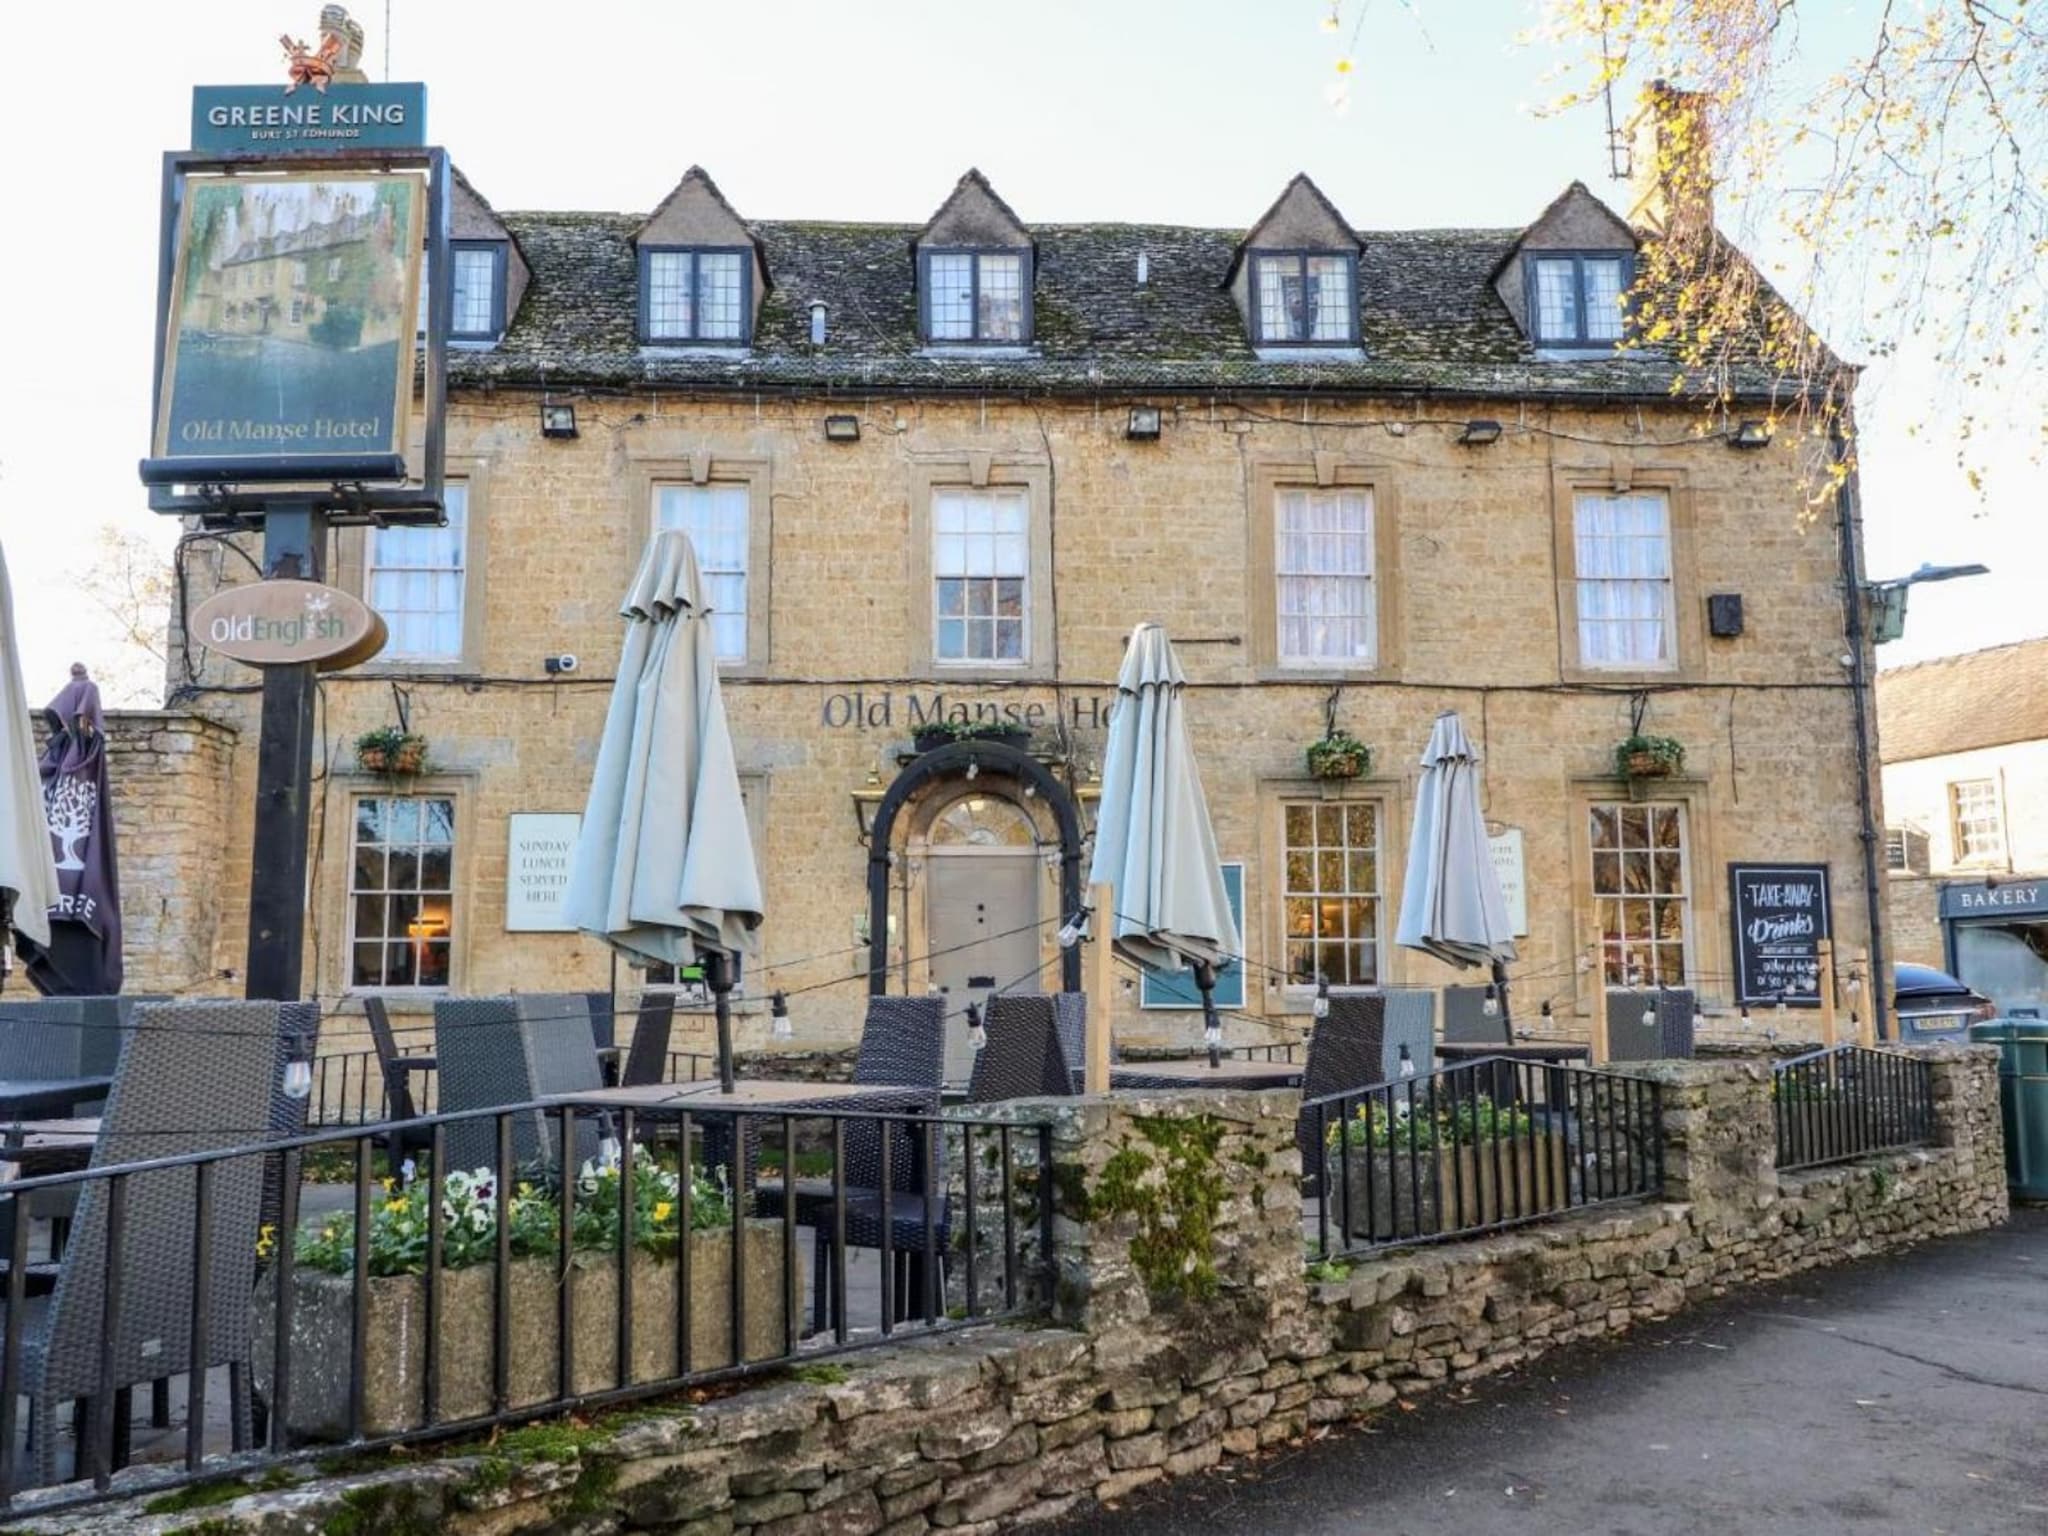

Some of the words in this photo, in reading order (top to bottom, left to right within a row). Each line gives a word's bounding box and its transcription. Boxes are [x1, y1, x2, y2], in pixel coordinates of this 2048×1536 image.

[208, 105, 320, 126] GREENE
[332, 104, 405, 124] KING
[182, 420, 222, 441] Old
[227, 420, 308, 439] Manse
[314, 416, 380, 438] Hotel
[824, 693, 892, 728] Old
[907, 694, 1045, 727] Manse
[1073, 697, 1113, 728] Ho
[519, 841, 570, 852] SUNDAY
[523, 858, 566, 869] LUNCH
[1961, 888, 2037, 908] BAKERY
